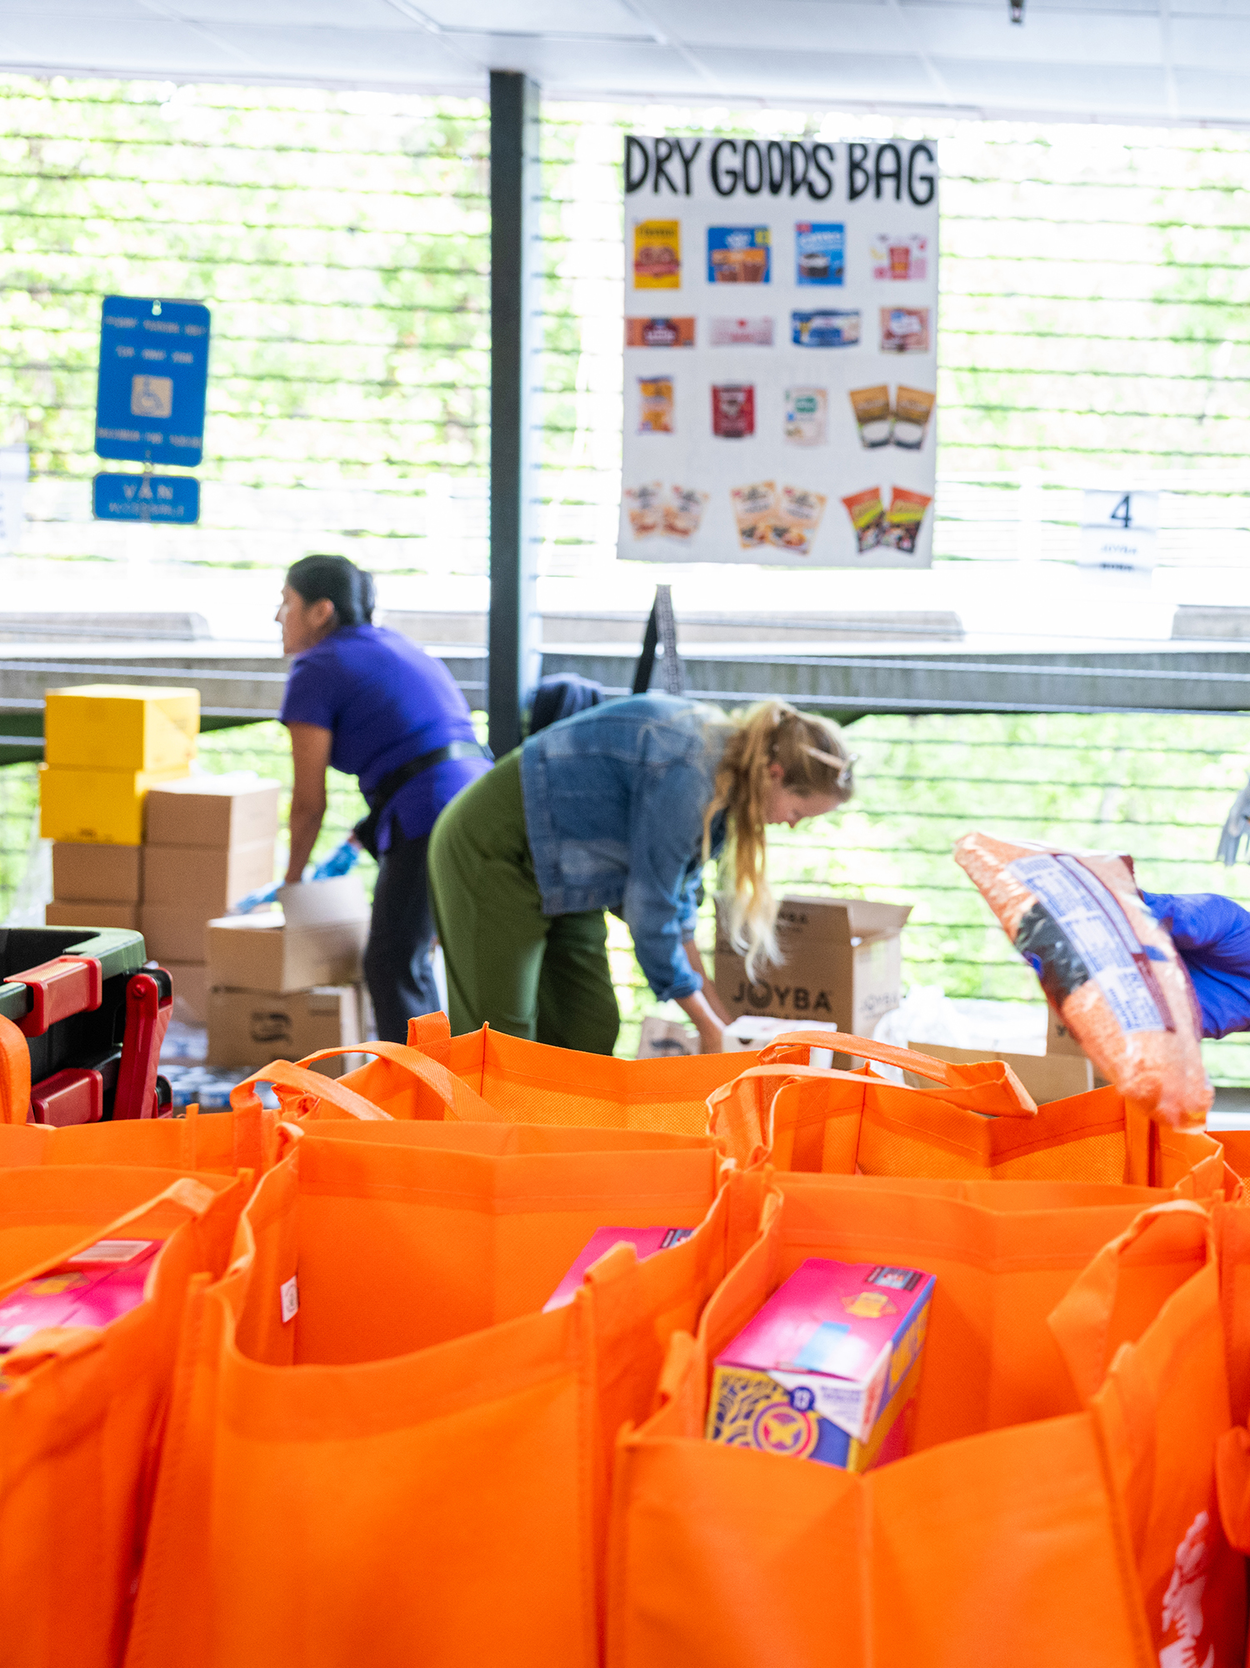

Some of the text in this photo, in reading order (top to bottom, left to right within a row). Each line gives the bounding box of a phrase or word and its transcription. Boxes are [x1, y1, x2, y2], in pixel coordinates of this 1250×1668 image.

[625, 136, 935, 205] DRY GOODS BAG
[1111, 494, 1132, 528] 4
[732, 978, 832, 1012] JOYBA
